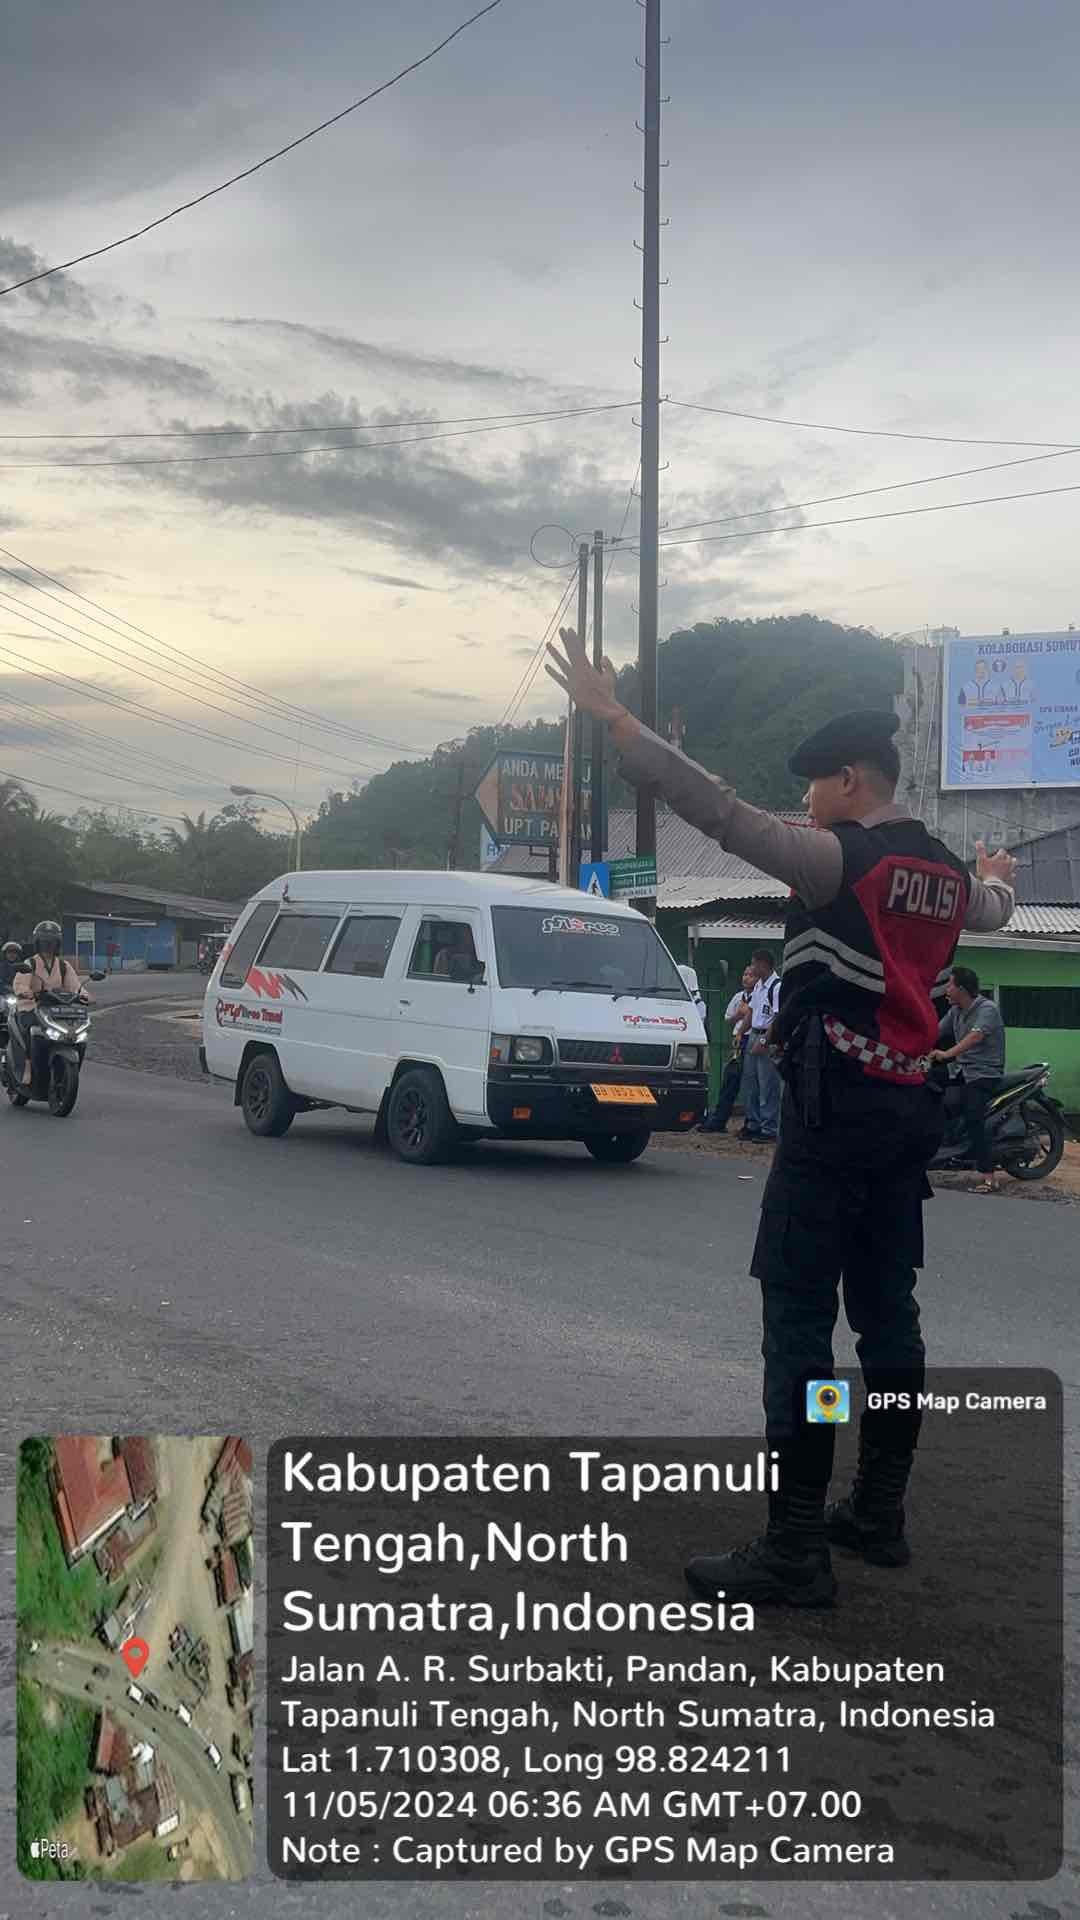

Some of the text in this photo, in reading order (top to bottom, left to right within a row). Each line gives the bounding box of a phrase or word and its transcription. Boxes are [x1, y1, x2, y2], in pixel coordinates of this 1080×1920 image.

[978, 639, 1080, 656] KOLABORASI SUMU
[502, 759, 538, 778] ANDA
[888, 868, 961, 921] POLISI
